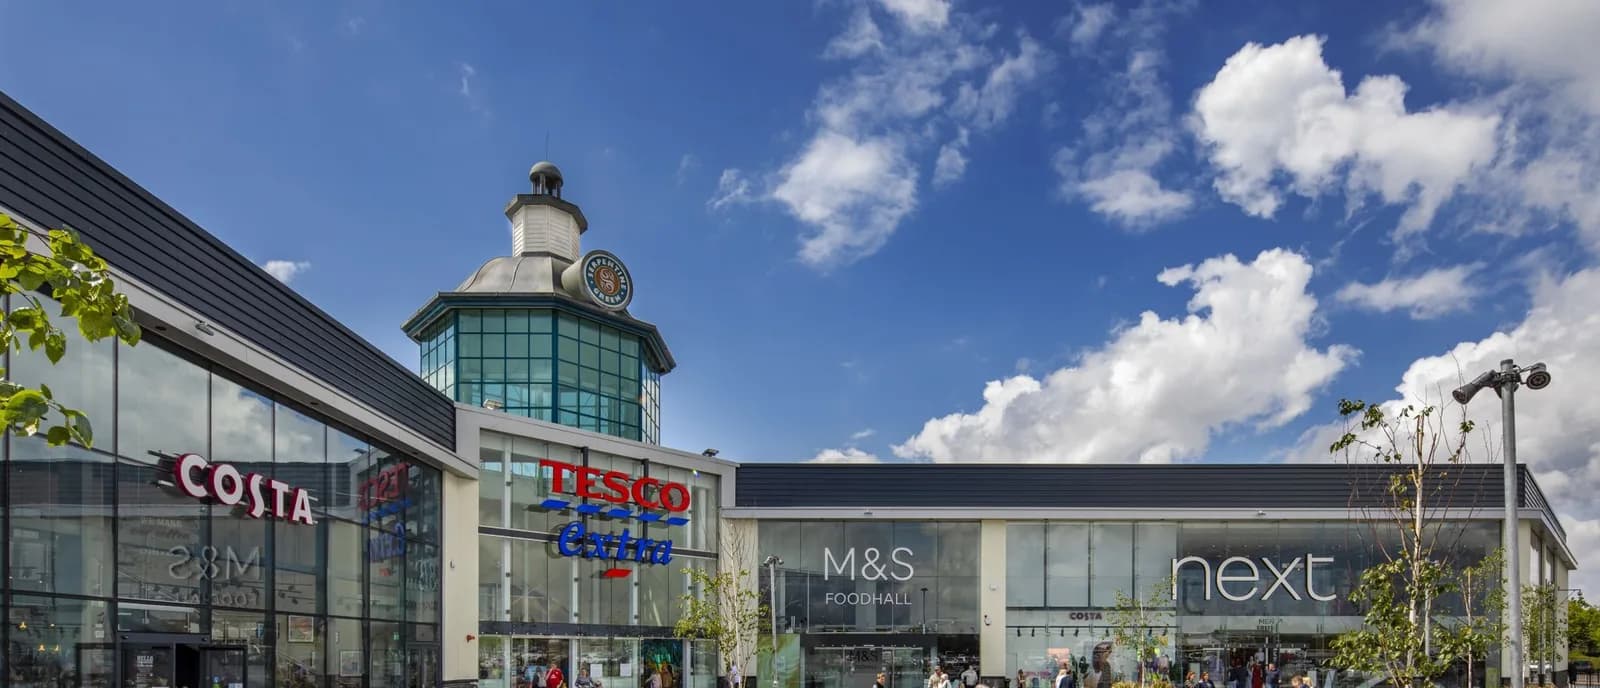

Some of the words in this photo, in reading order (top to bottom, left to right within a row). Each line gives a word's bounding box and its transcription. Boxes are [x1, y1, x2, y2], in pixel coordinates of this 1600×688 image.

[587, 258, 627, 290] SERPENTINE
[593, 288, 621, 304] GREEN
[174, 453, 316, 525] COSTA
[539, 459, 690, 512] TESCO
[558, 520, 673, 565] extra
[824, 547, 914, 581] M&S
[1170, 552, 1337, 602] next
[825, 592, 912, 606] FOODHALL
[1069, 612, 1102, 621] COSTA
